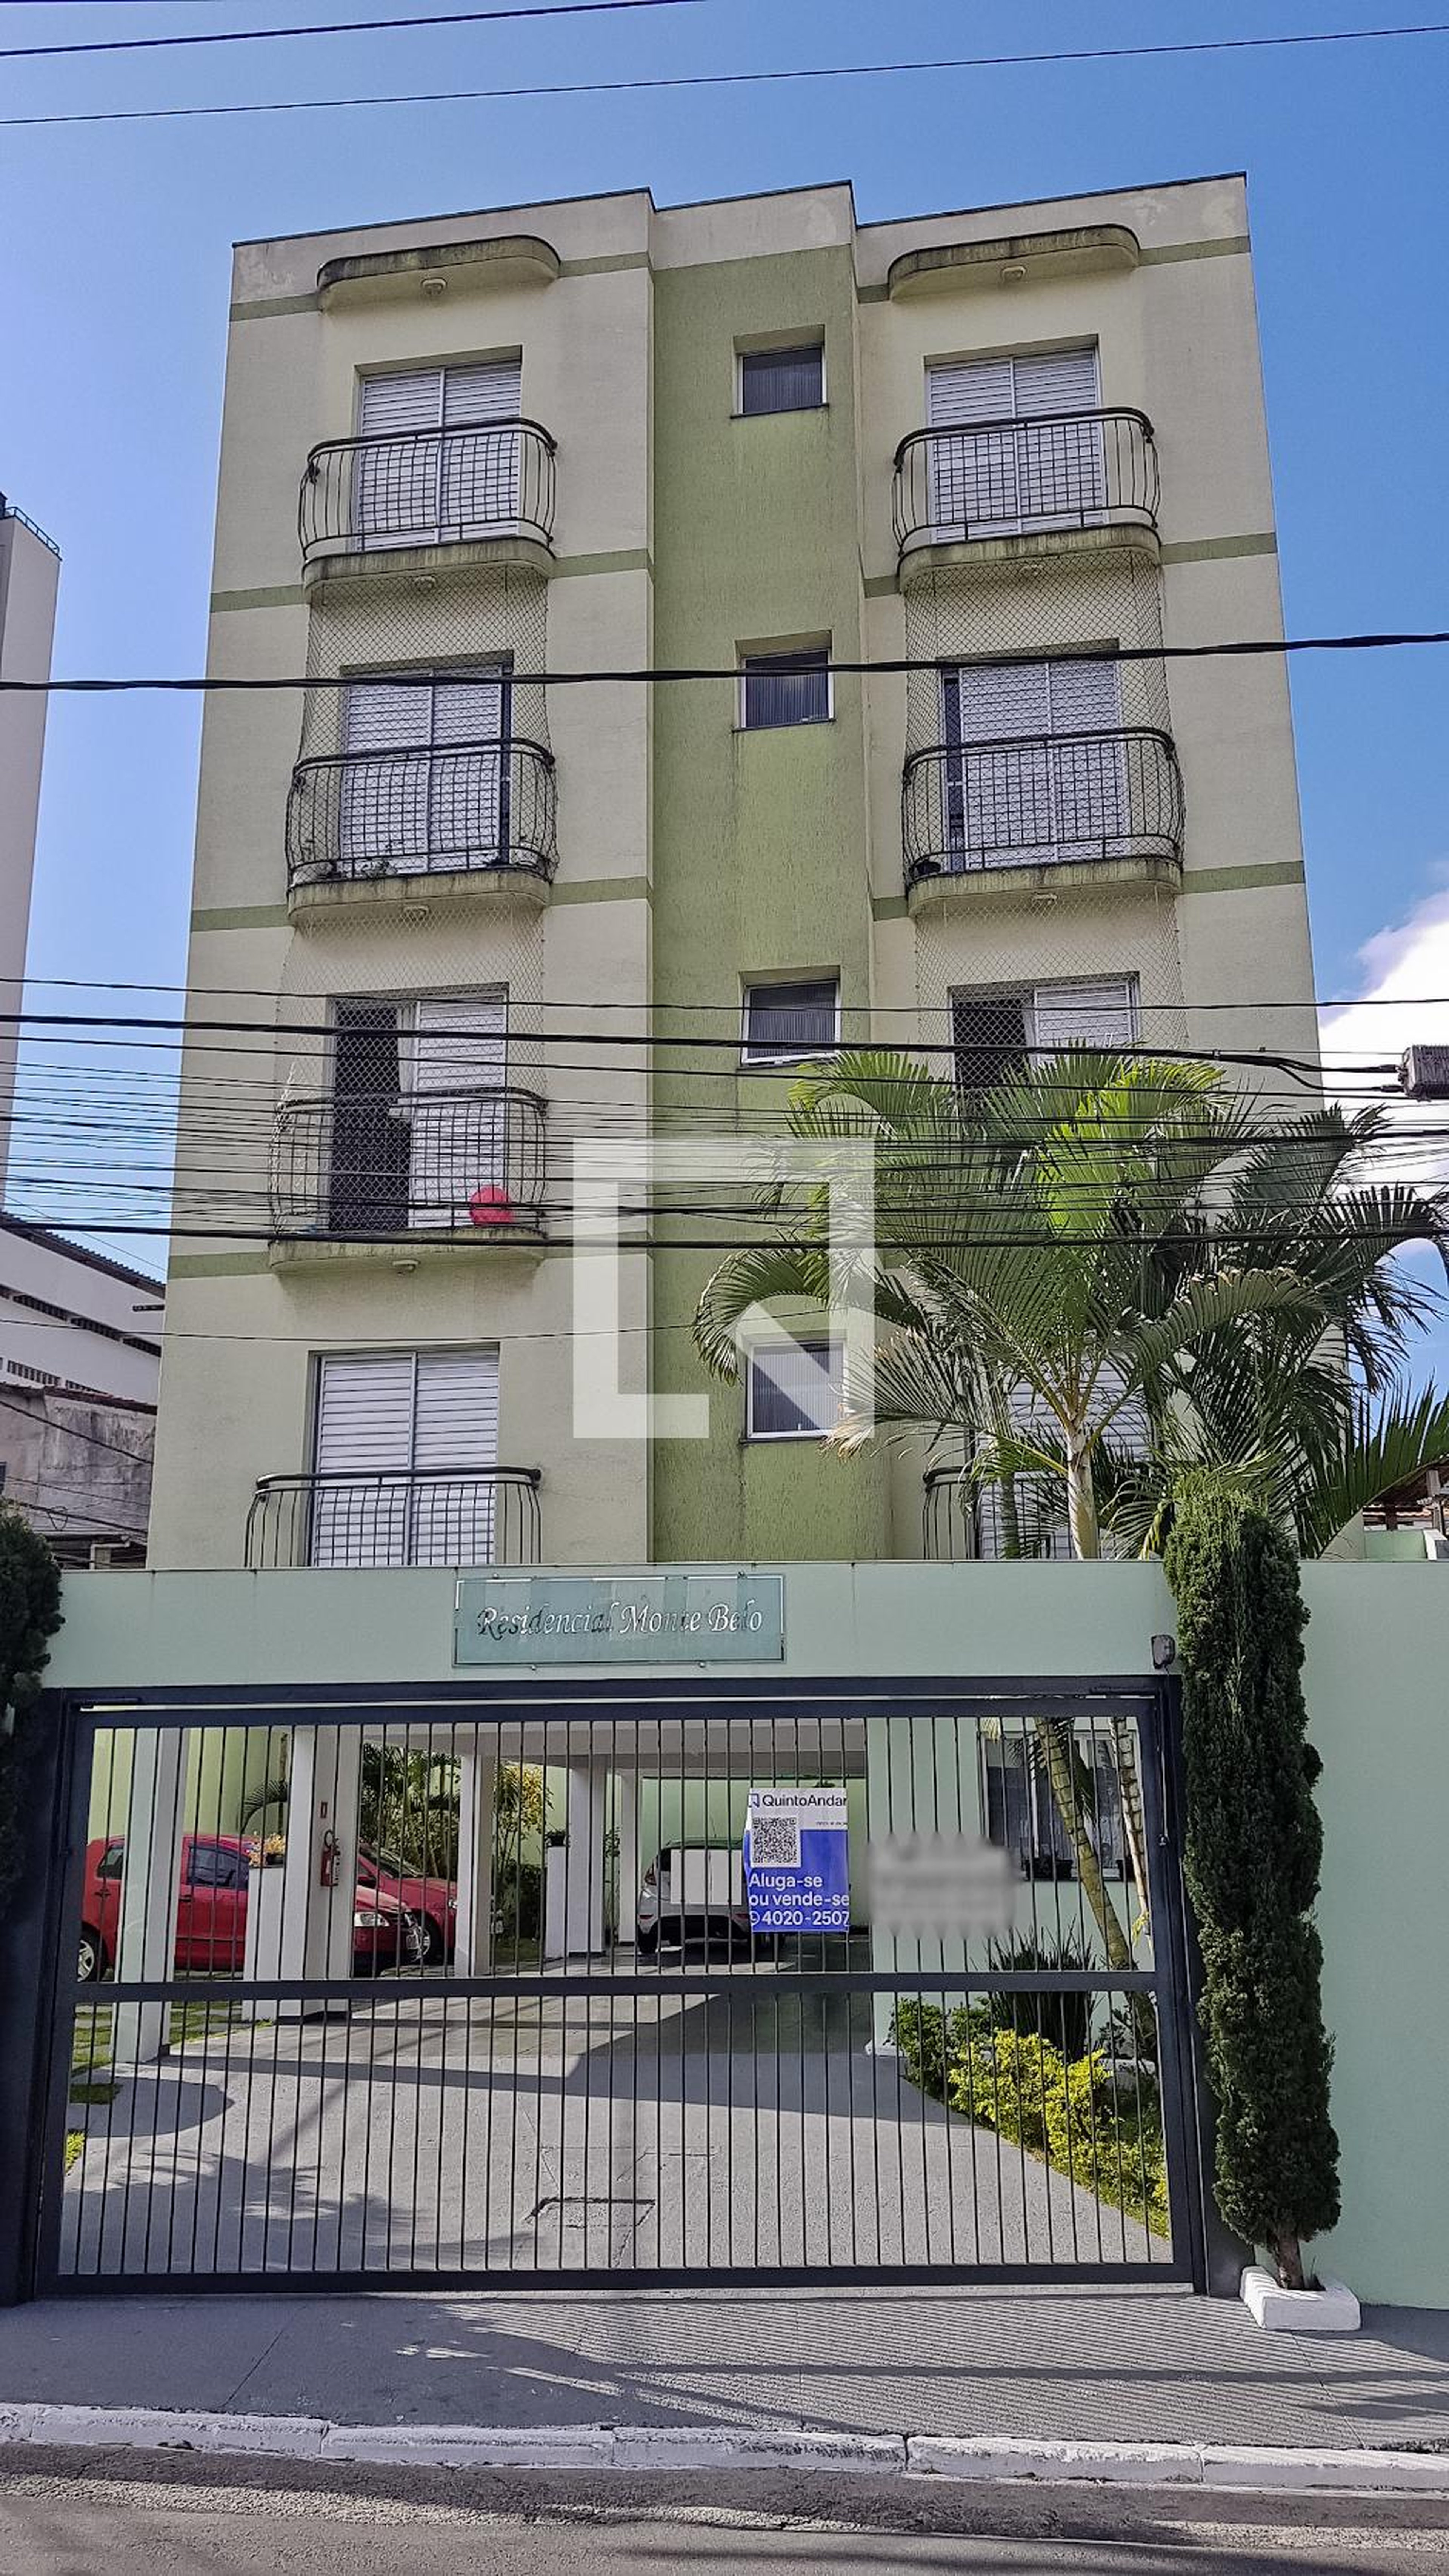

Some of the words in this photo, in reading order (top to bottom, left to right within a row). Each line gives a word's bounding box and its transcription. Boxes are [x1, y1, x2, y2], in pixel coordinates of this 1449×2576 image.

[477, 1602, 620, 1640] Residencial
[620, 1605, 701, 1633] Monte
[708, 1600, 762, 1631] Belo
[762, 1794, 847, 1806] QuintoAndar
[749, 1873, 823, 1891] Aluga-se
[749, 1894, 769, 1906] ou
[772, 1891, 849, 1906] vende-se
[762, 1910, 849, 1926] 4020-2507
